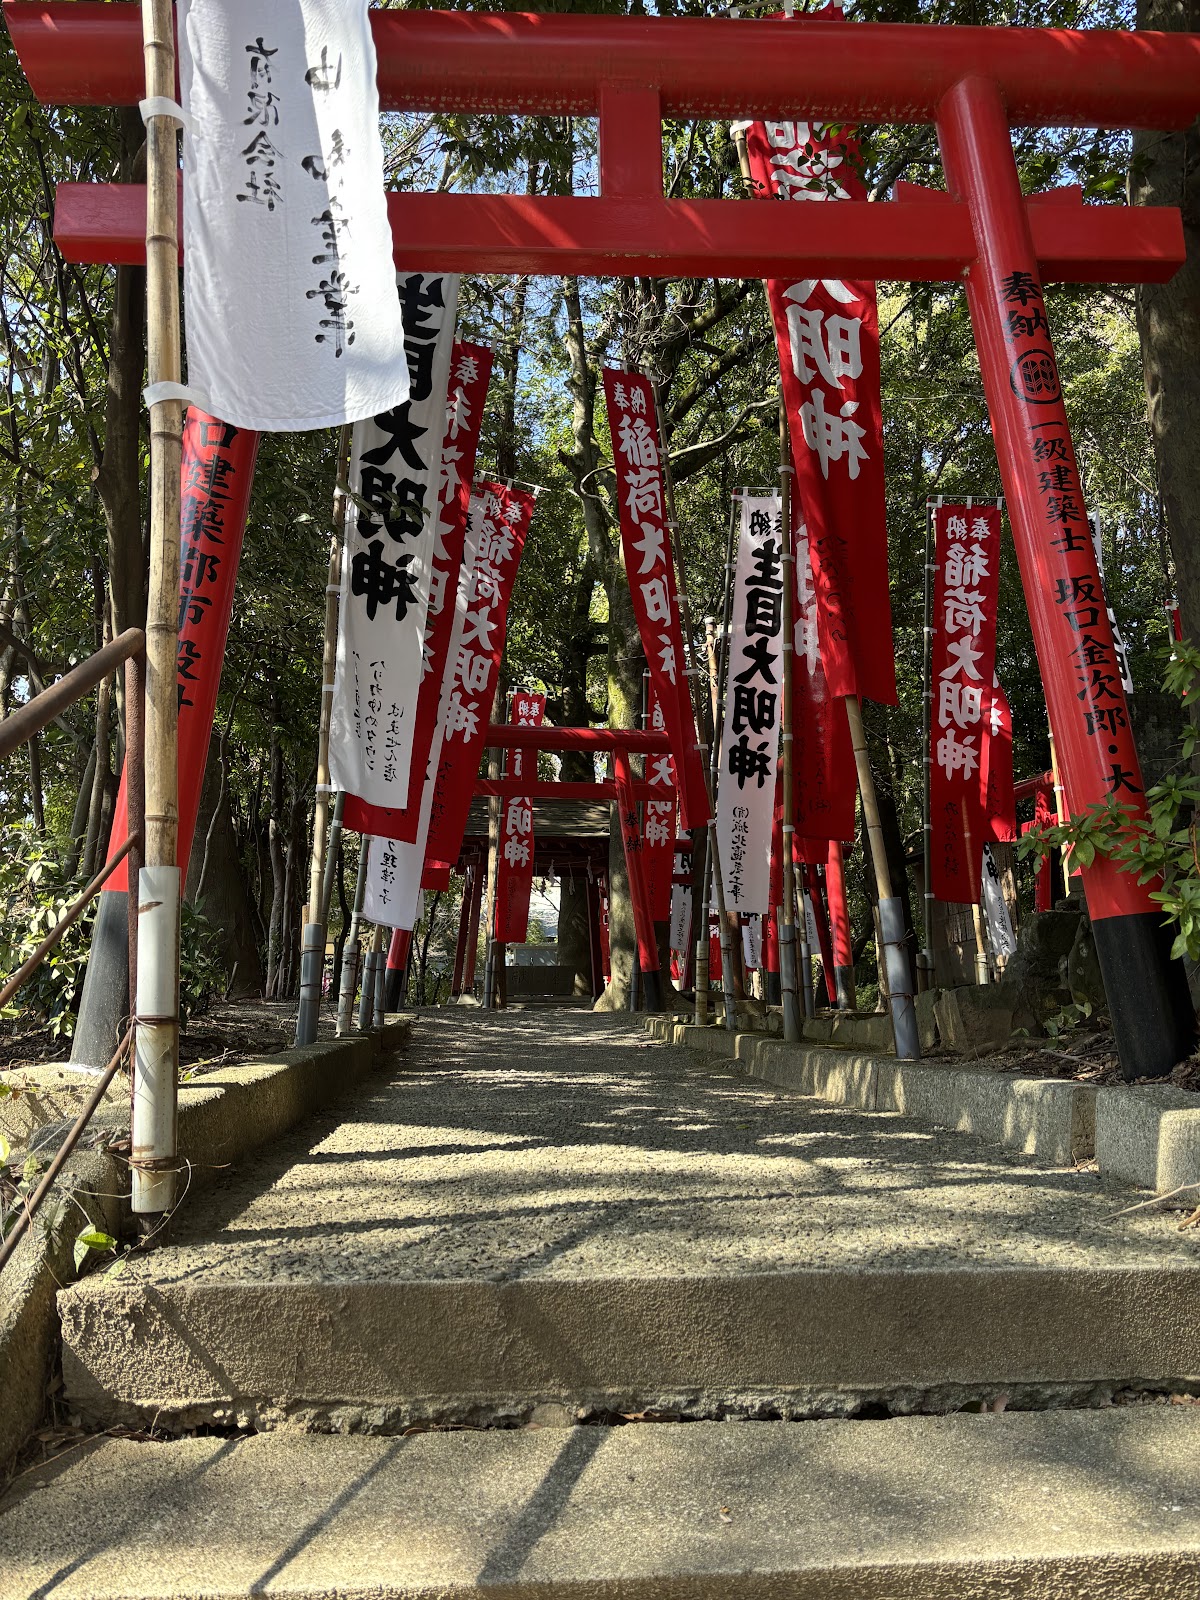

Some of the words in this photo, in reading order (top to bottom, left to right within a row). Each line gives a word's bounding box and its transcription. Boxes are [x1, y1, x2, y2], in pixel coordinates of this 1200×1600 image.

[1000, 270, 1050, 344] 奉納
[613, 381, 647, 415] 奉納
[1030, 420, 1087, 554] 一級建築士
